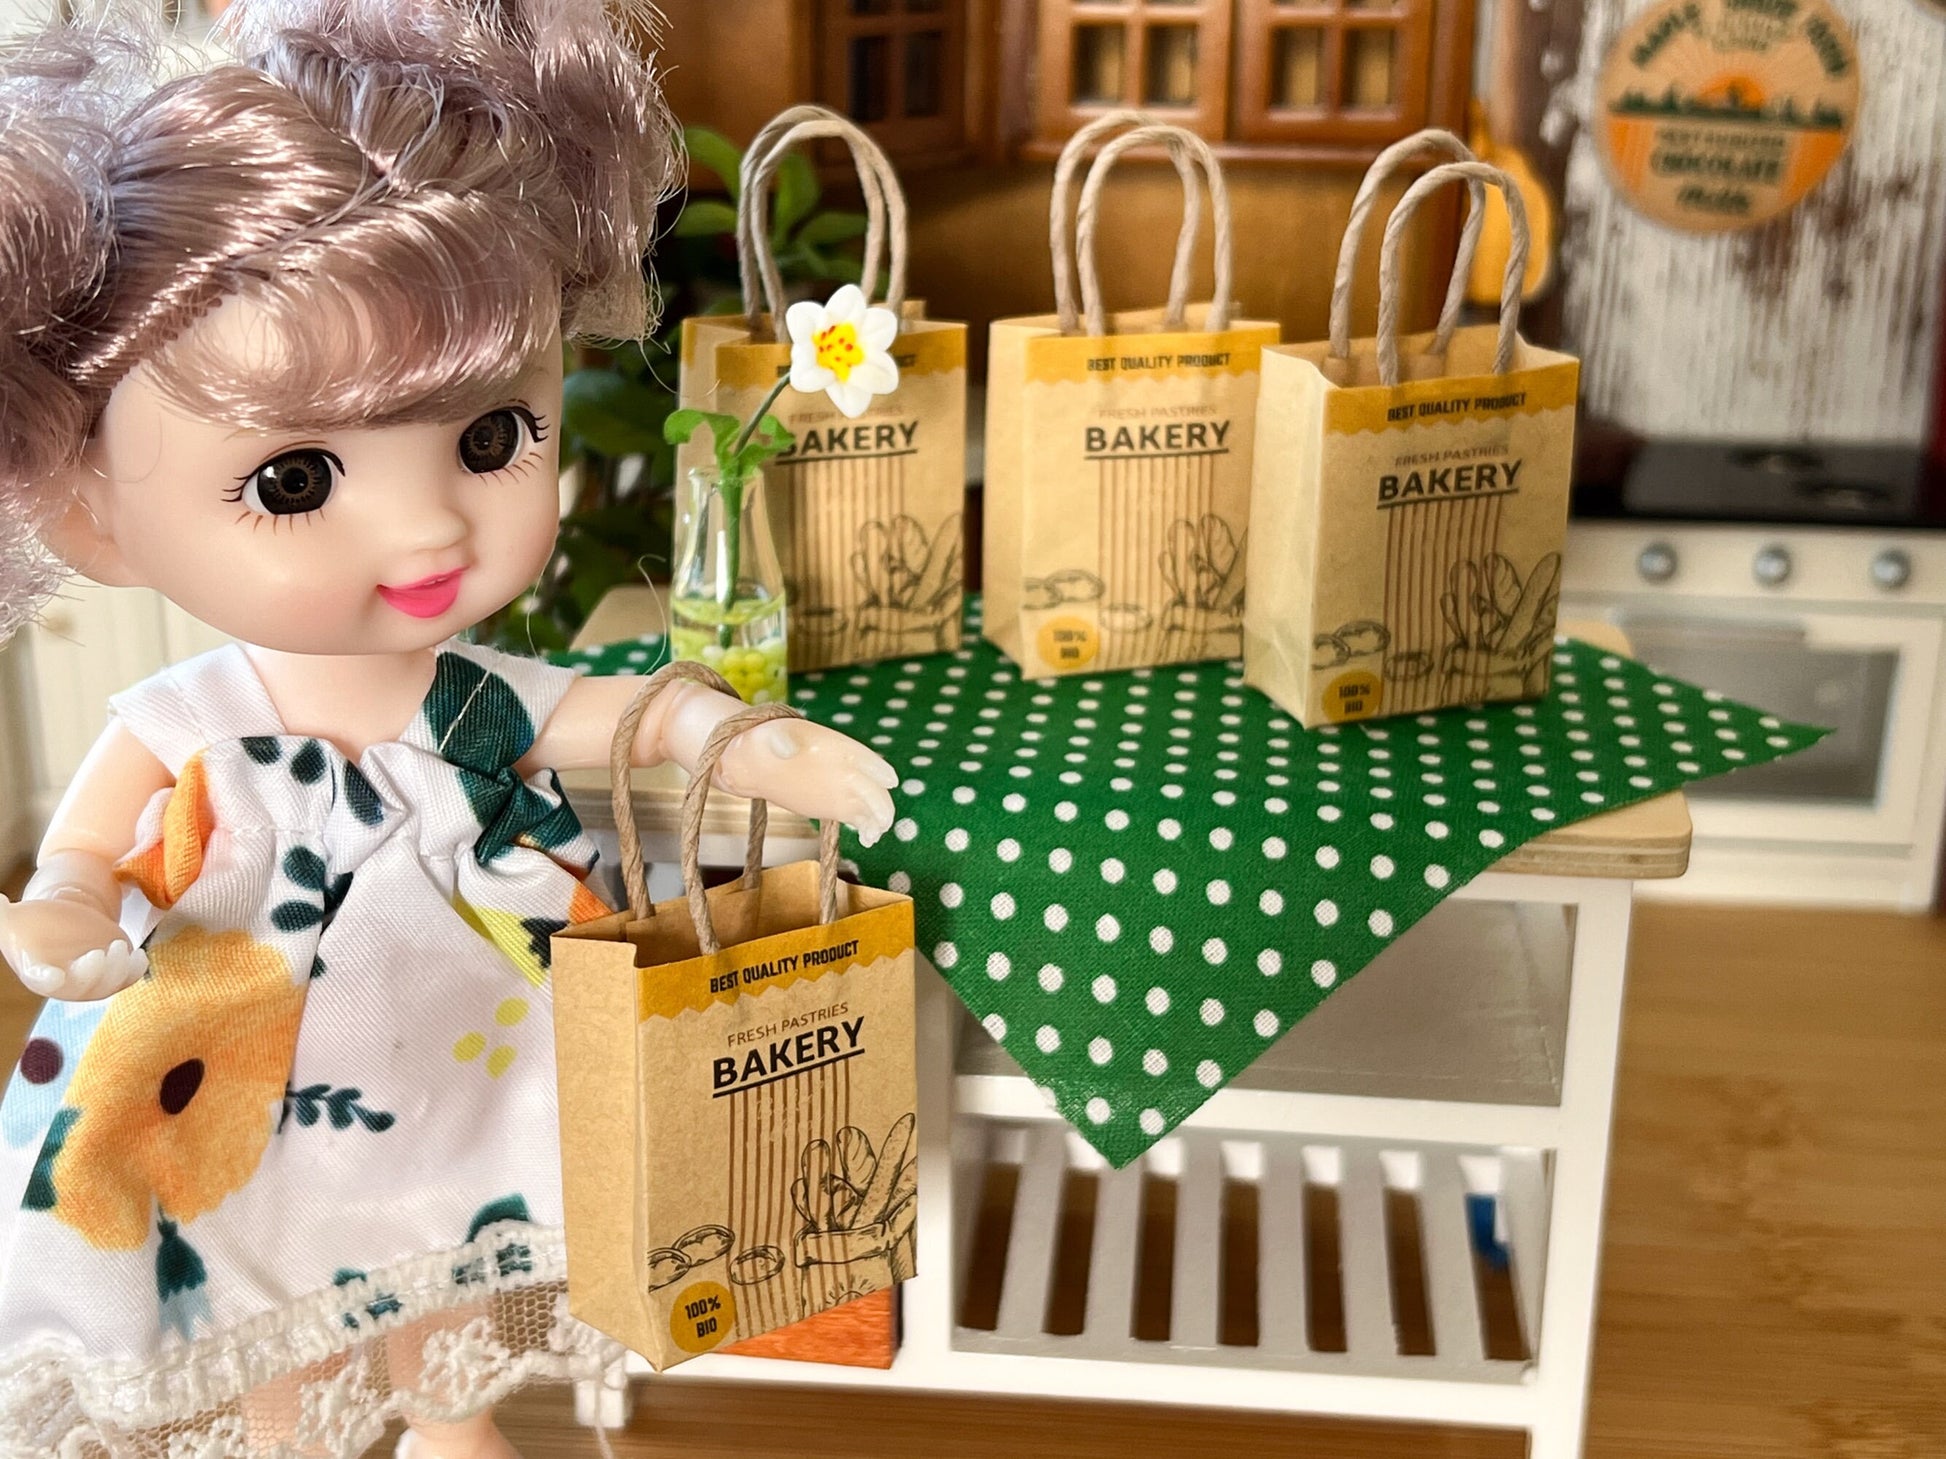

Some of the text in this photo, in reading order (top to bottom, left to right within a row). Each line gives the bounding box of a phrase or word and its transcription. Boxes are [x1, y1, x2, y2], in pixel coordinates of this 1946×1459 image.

[1087, 353, 1230, 371] BEST QUALITY PRODUCT
[1388, 392, 1526, 421] BEST QUALITY PRODUCT
[1085, 420, 1231, 452] BAKERY
[1395, 445, 1508, 467] FRESH PASTRIES
[1378, 459, 1523, 501] BAKERY
[710, 940, 859, 994] BEST QUALITY PRODUCT
[727, 1002, 849, 1048] FRESH PASTRIES
[713, 1016, 865, 1090] BAKERY
[685, 1294, 722, 1320] 100%
[696, 1316, 717, 1338] BIO
